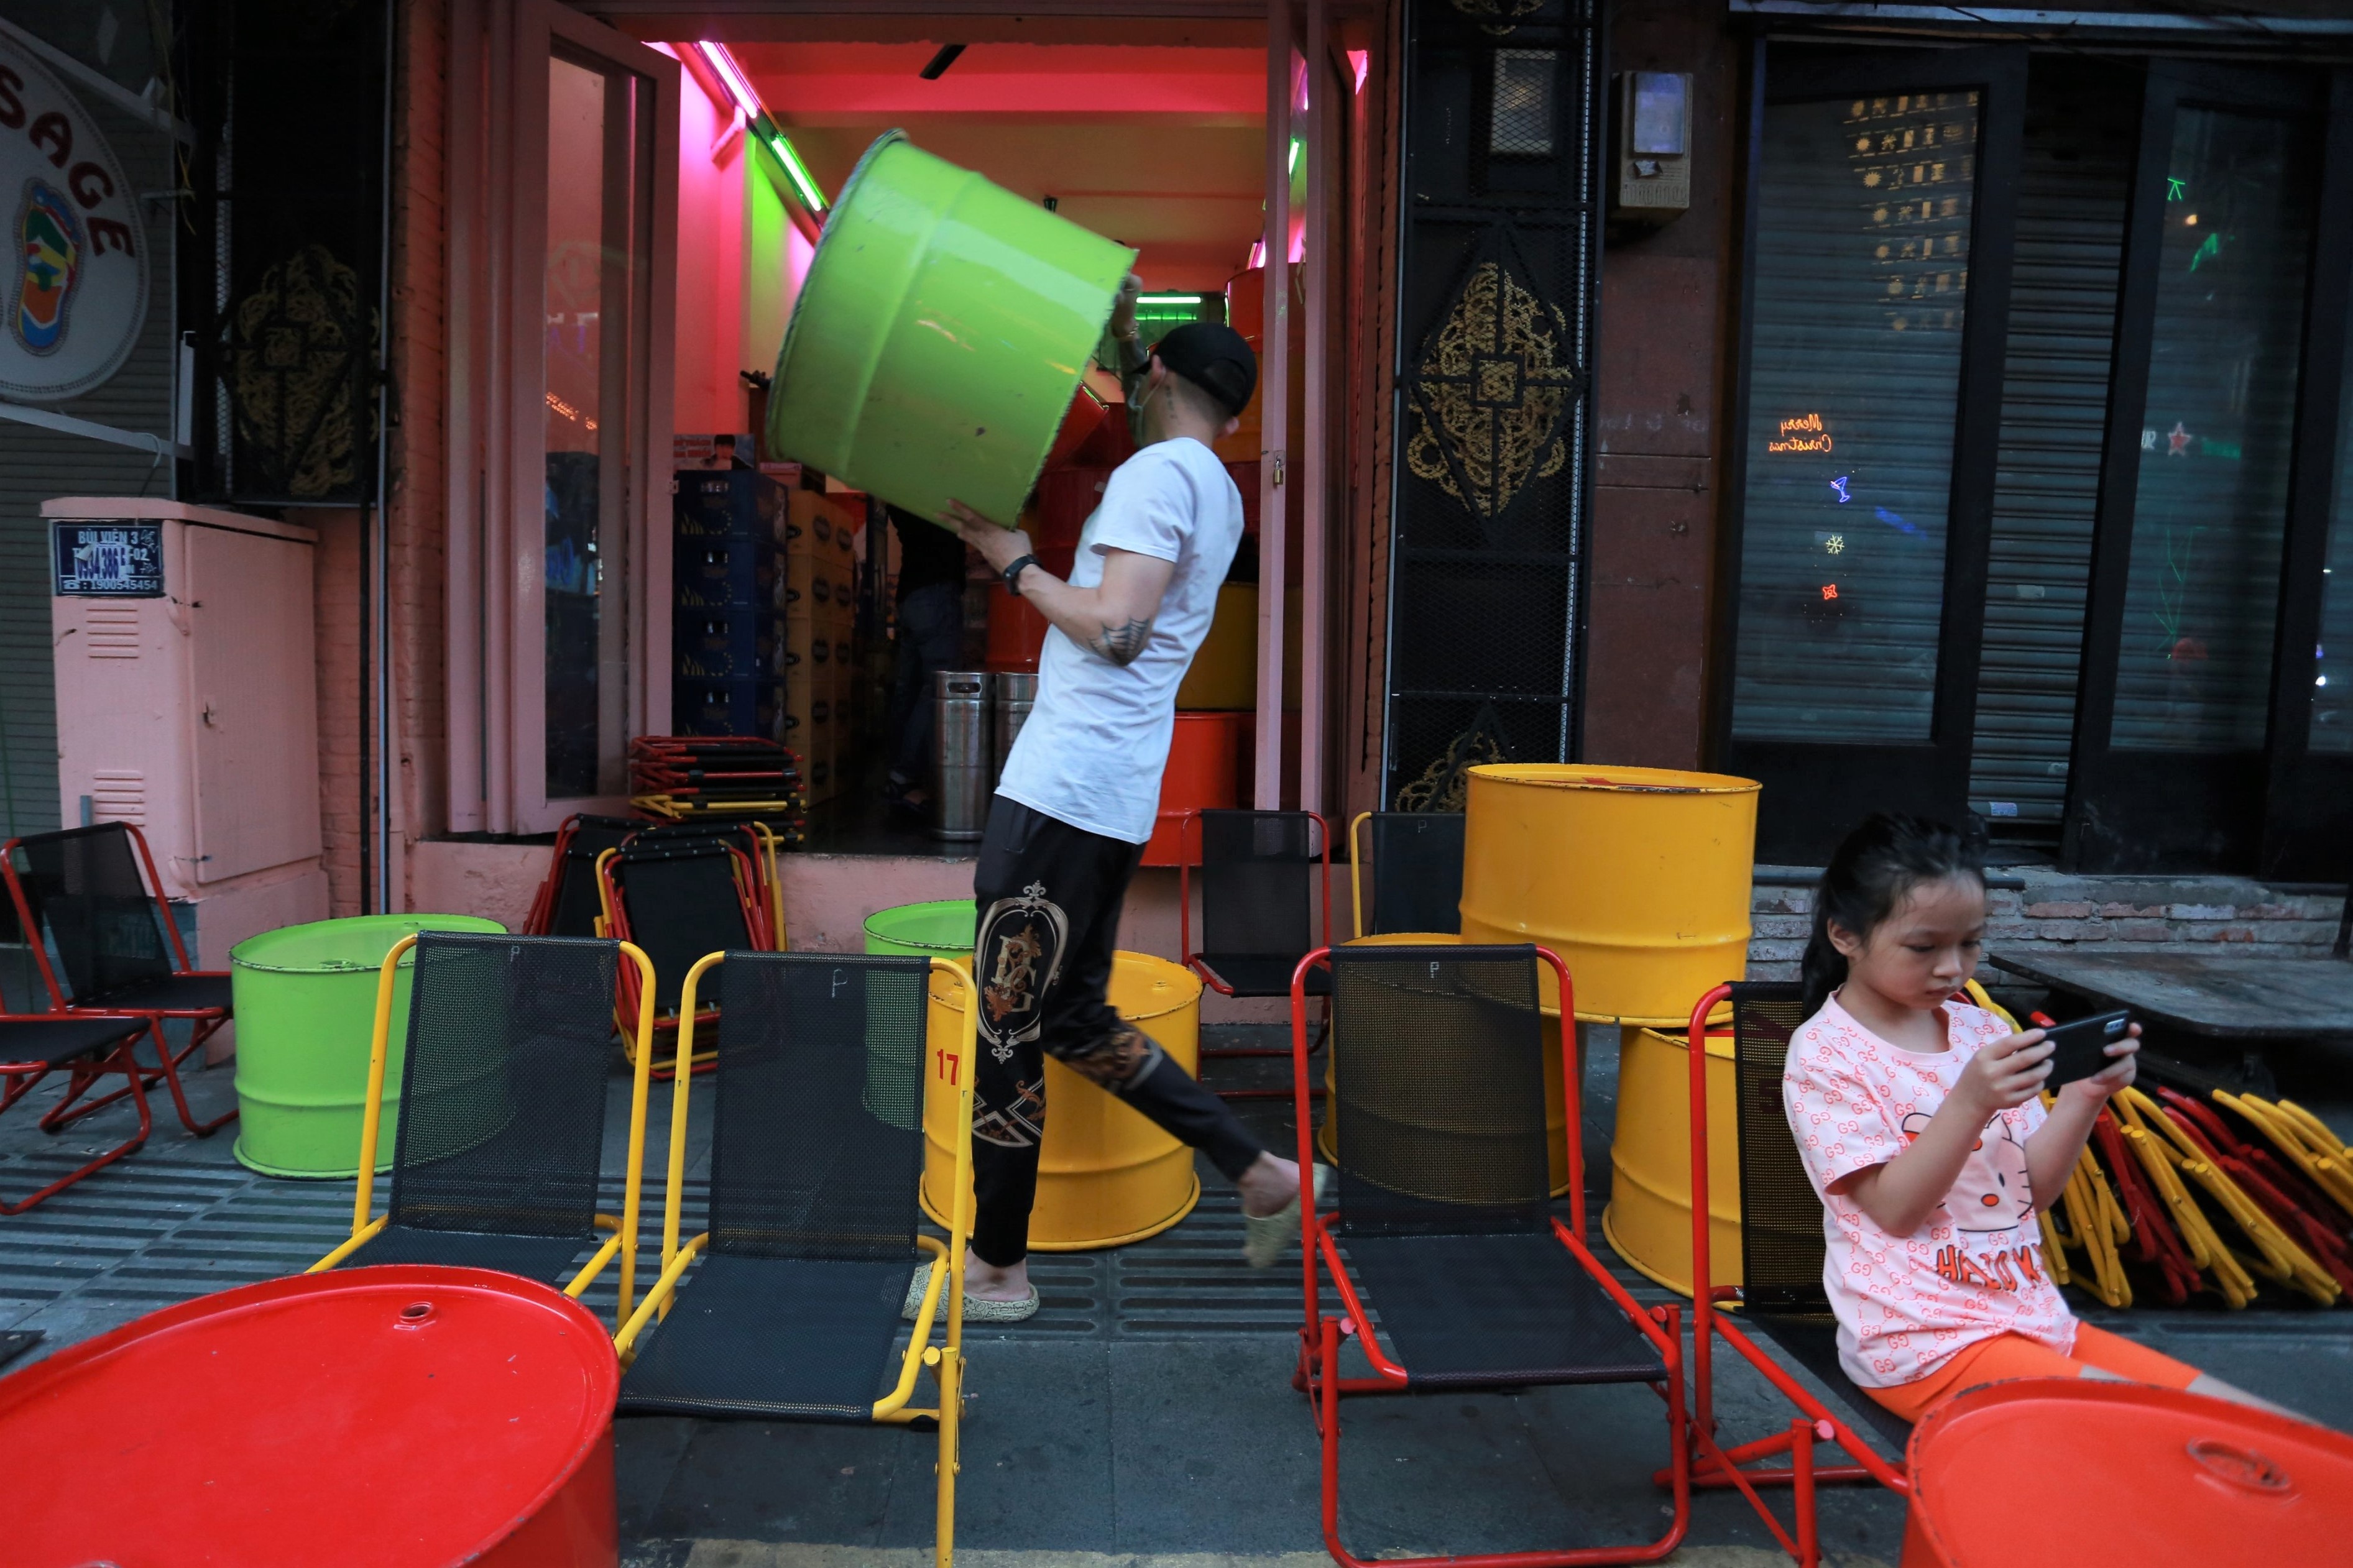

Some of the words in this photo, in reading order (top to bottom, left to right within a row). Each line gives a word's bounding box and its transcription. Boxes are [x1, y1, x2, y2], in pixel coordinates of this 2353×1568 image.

[131, 531, 139, 544] 3
[1417, 820, 1427, 833] P
[1430, 961, 1439, 978] P
[937, 1048, 959, 1086] 17
